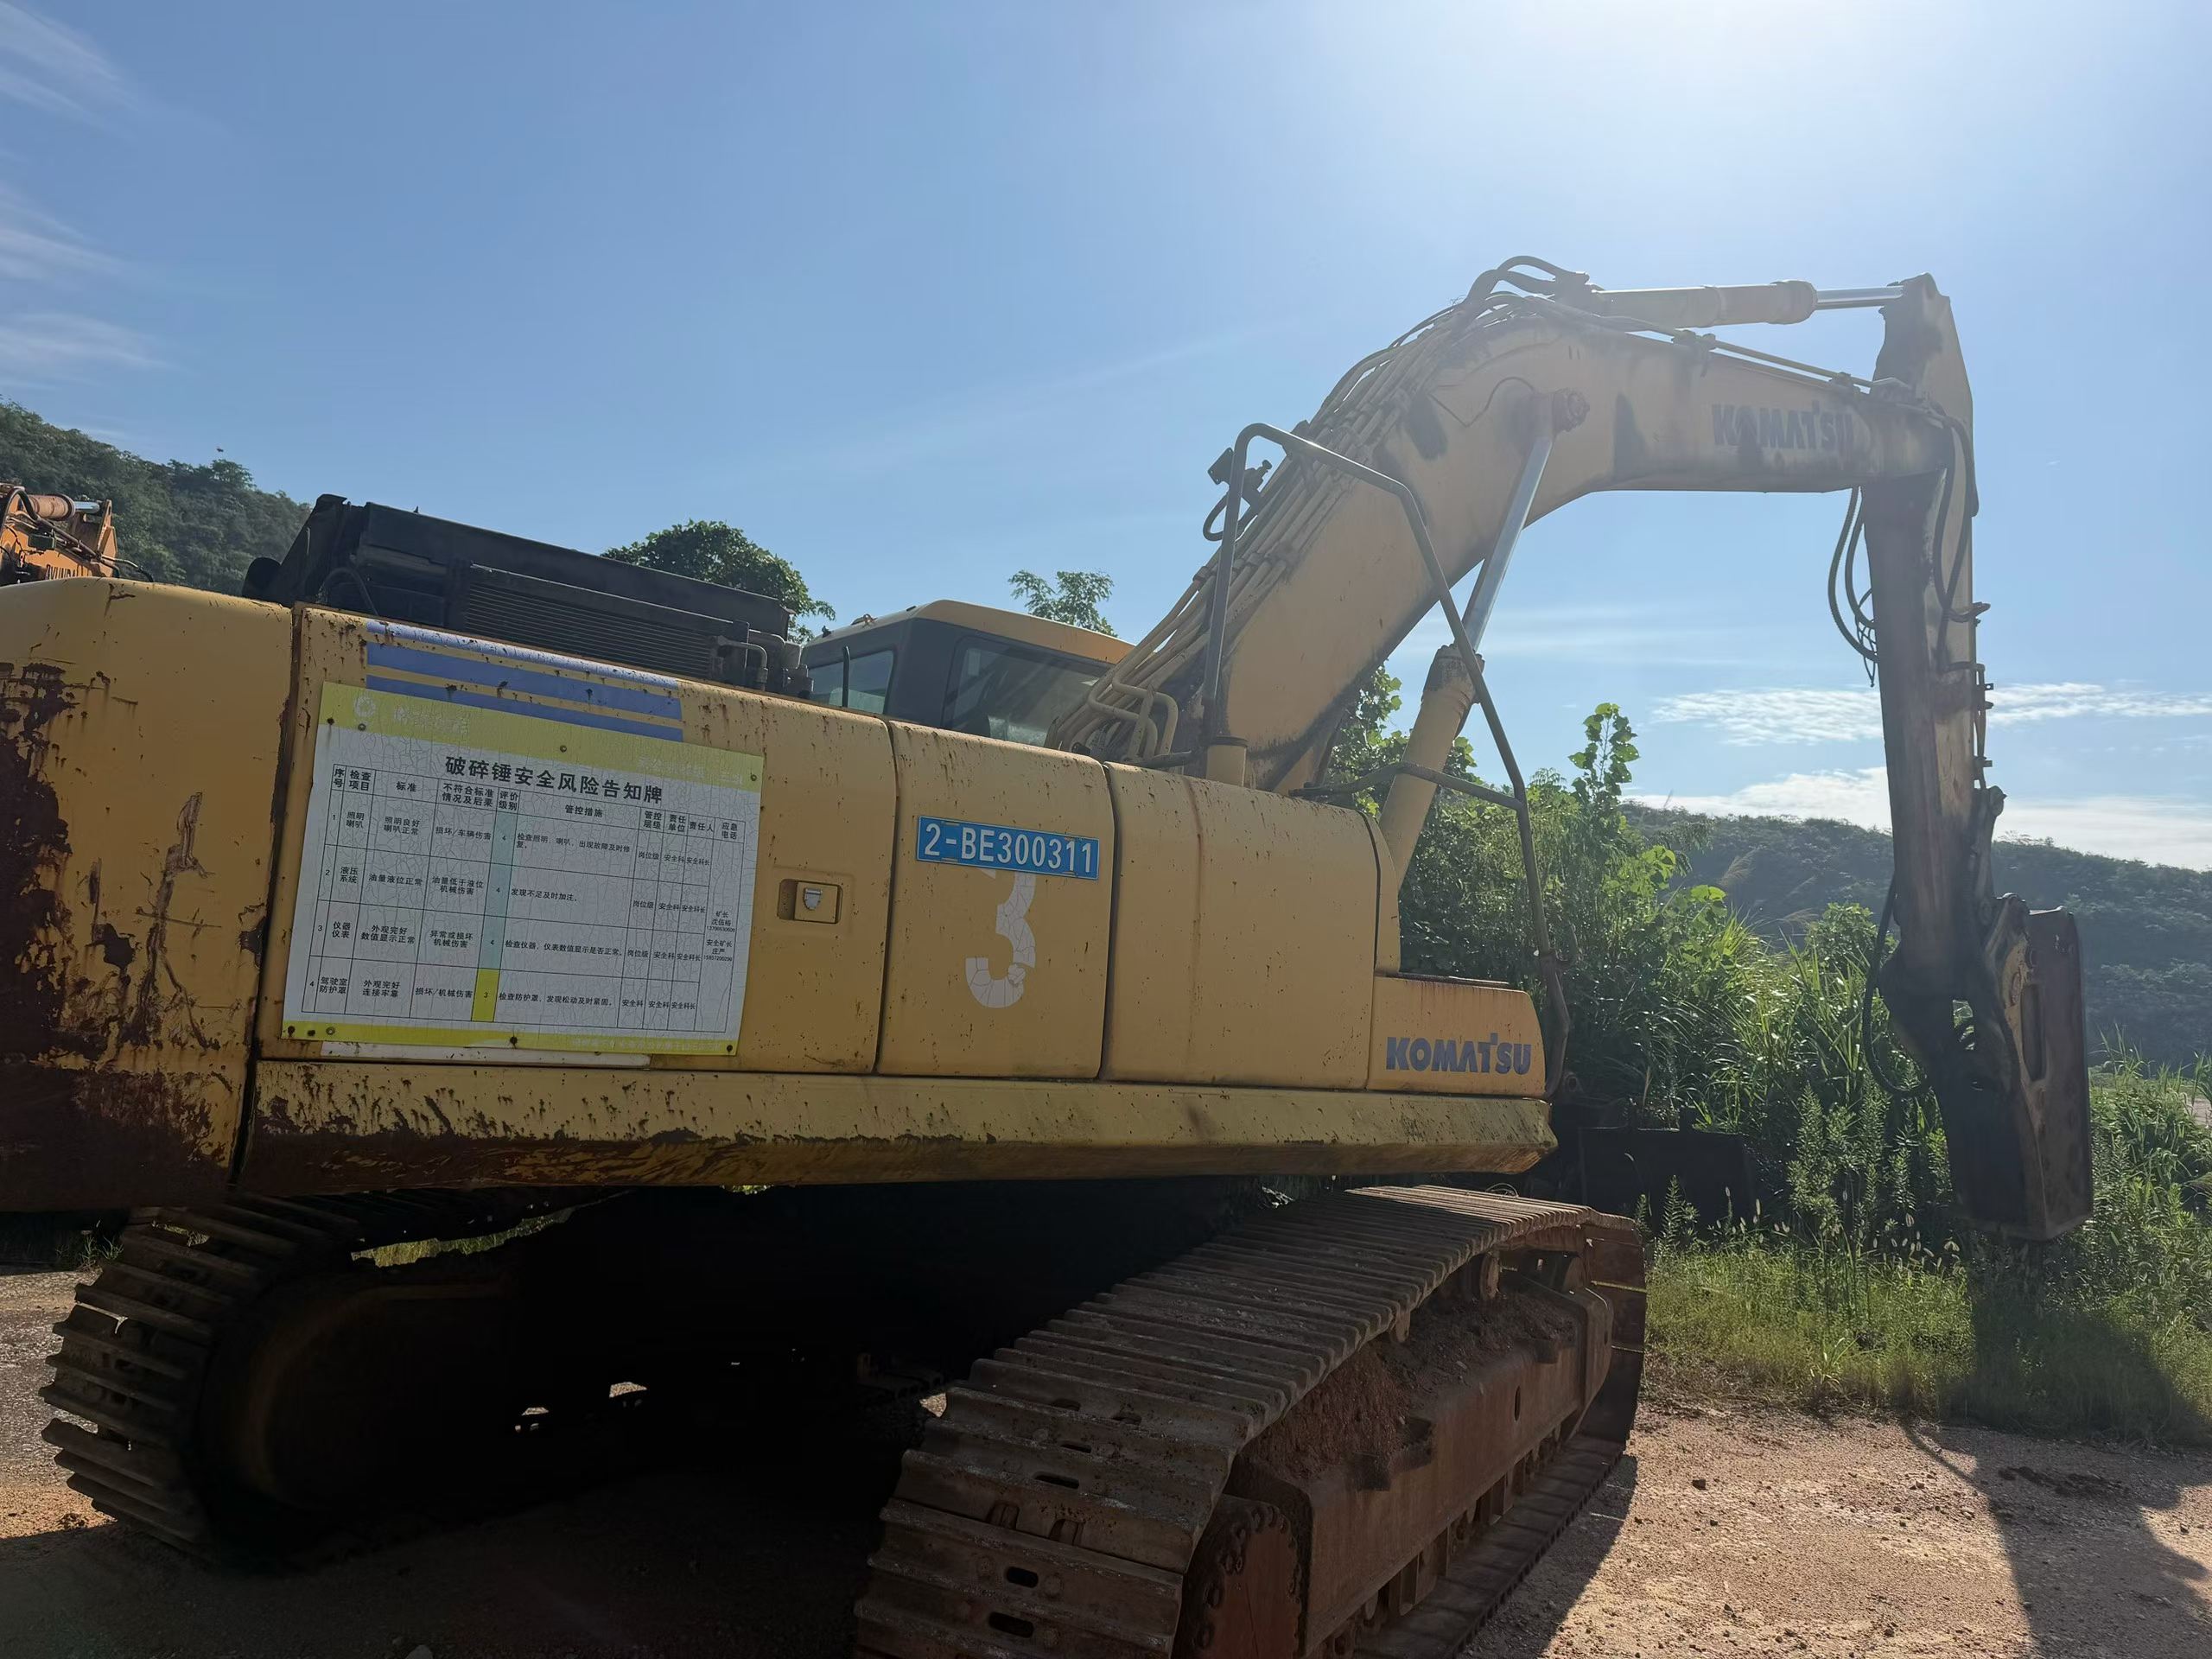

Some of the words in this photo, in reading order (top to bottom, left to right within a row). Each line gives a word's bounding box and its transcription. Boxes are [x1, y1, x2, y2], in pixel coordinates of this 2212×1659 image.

[1712, 400, 1853, 450] KOMATSU
[349, 769, 371, 781] 检查
[445, 756, 663, 804] 破碎锤安全风险告知牌
[348, 780, 370, 791] 项目
[396, 781, 416, 792] 标准
[443, 783, 494, 798] 不符合标准
[442, 791, 493, 807] 情况及后果
[499, 791, 518, 801] 评价
[498, 800, 518, 810] 级别
[564, 804, 603, 818] 管控措施
[644, 810, 662, 820] 管控
[346, 812, 365, 821] 照明
[669, 814, 686, 823] 责任
[346, 820, 364, 829] 喇叭
[385, 817, 420, 828] 照明良好
[667, 823, 685, 832] 单位
[689, 821, 714, 832] 责任人
[721, 822, 738, 831] 应急
[384, 824, 419, 836] 喇叭正常
[435, 826, 492, 840] 损坏/车辆伤害
[721, 830, 738, 840] 电话
[925, 823, 1091, 873] 2-BE300311
[638, 850, 659, 861] 岗位级
[664, 853, 684, 862] 安全科
[686, 856, 710, 866] 安全科长
[340, 867, 358, 875] 液压
[340, 874, 357, 884] 系统
[368, 874, 423, 887] 油量液位正常
[432, 876, 484, 888] 油量低于液位
[440, 885, 474, 895] 机械伤害
[632, 900, 654, 909] 岗位级
[658, 902, 680, 911] 安全科
[682, 904, 706, 913] 安全科长
[333, 921, 351, 931] 仪器
[371, 925, 408, 935] 外观完好
[332, 930, 350, 938] 仪表
[360, 932, 416, 944] 数值显示正常
[429, 931, 473, 941] 异常或损坏
[433, 938, 468, 948] 机械伤害
[965, 871, 1037, 1008] 3
[627, 950, 649, 958] 岗位级
[677, 952, 701, 962] 安全科长
[321, 976, 347, 986] 驾驶室
[363, 980, 400, 989] 外观完好
[319, 985, 347, 995] 防护罩
[362, 988, 398, 997] 连接牢靠
[415, 987, 473, 999] 损坏/机械伤害
[621, 999, 644, 1007] 安全科
[671, 1001, 696, 1010] 安全科长
[1386, 1033, 1531, 1075] KOMATSU
